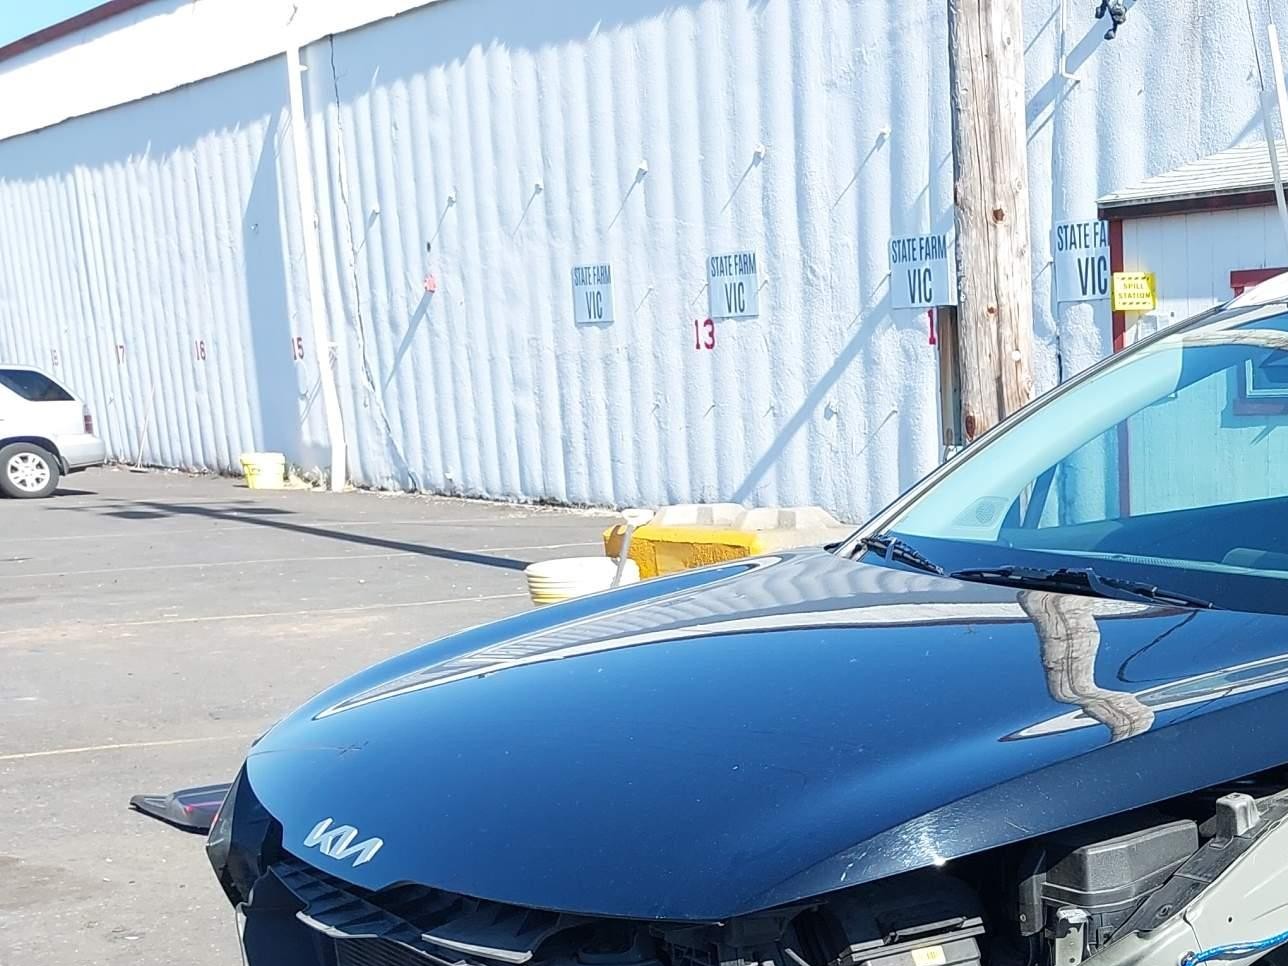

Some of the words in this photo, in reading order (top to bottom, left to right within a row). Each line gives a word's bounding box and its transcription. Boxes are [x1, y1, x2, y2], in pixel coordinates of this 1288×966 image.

[891, 237, 917, 264] STATE
[919, 234, 947, 261] FARM
[1057, 222, 1089, 252] STATE
[1093, 220, 1108, 248] FA
[574, 265, 592, 287] STATE
[593, 264, 611, 285] FARM
[711, 255, 732, 277] STATE
[734, 252, 756, 275] FARM
[1077, 254, 1108, 296] VIC
[725, 281, 745, 313] VIC
[907, 267, 932, 304] VIC
[585, 290, 602, 319] VIC
[694, 318, 715, 350] 13
[926, 308, 937, 345] 1
[115, 344, 125, 366] 17
[291, 336, 304, 361] 15
